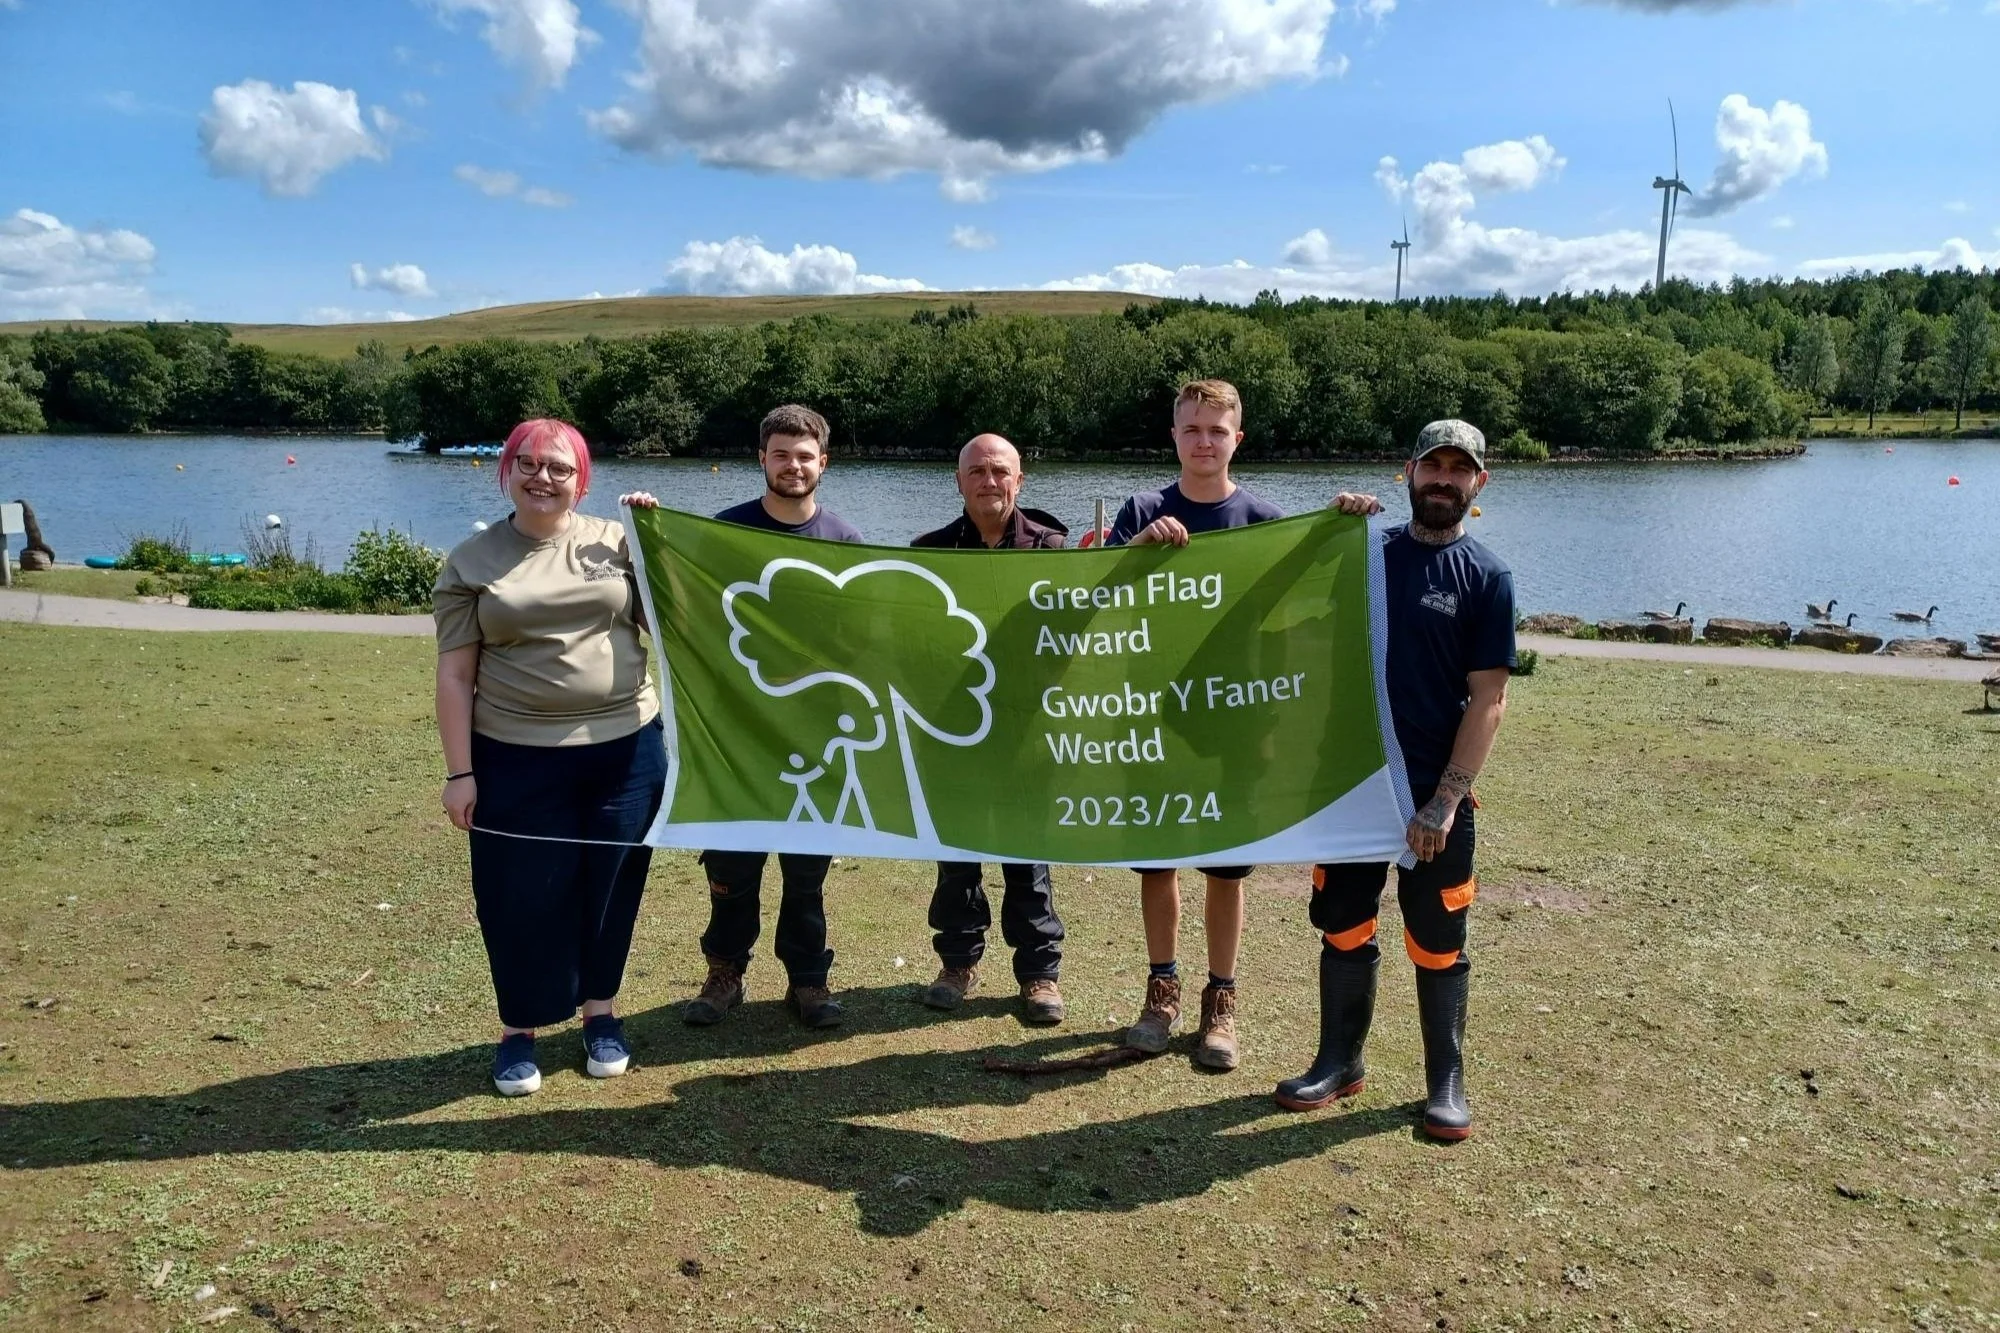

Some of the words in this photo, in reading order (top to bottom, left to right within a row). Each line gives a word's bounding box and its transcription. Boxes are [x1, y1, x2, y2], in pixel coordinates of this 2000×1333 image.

[1028, 579, 1135, 611] Green
[1147, 571, 1222, 609] Flag
[1034, 618, 1151, 656] Award
[1041, 682, 1162, 718] Gwobr
[1169, 679, 1194, 712] Y
[1205, 672, 1306, 710] Faner
[1045, 727, 1165, 765] Werdd
[1055, 791, 1223, 827] 2023/24
